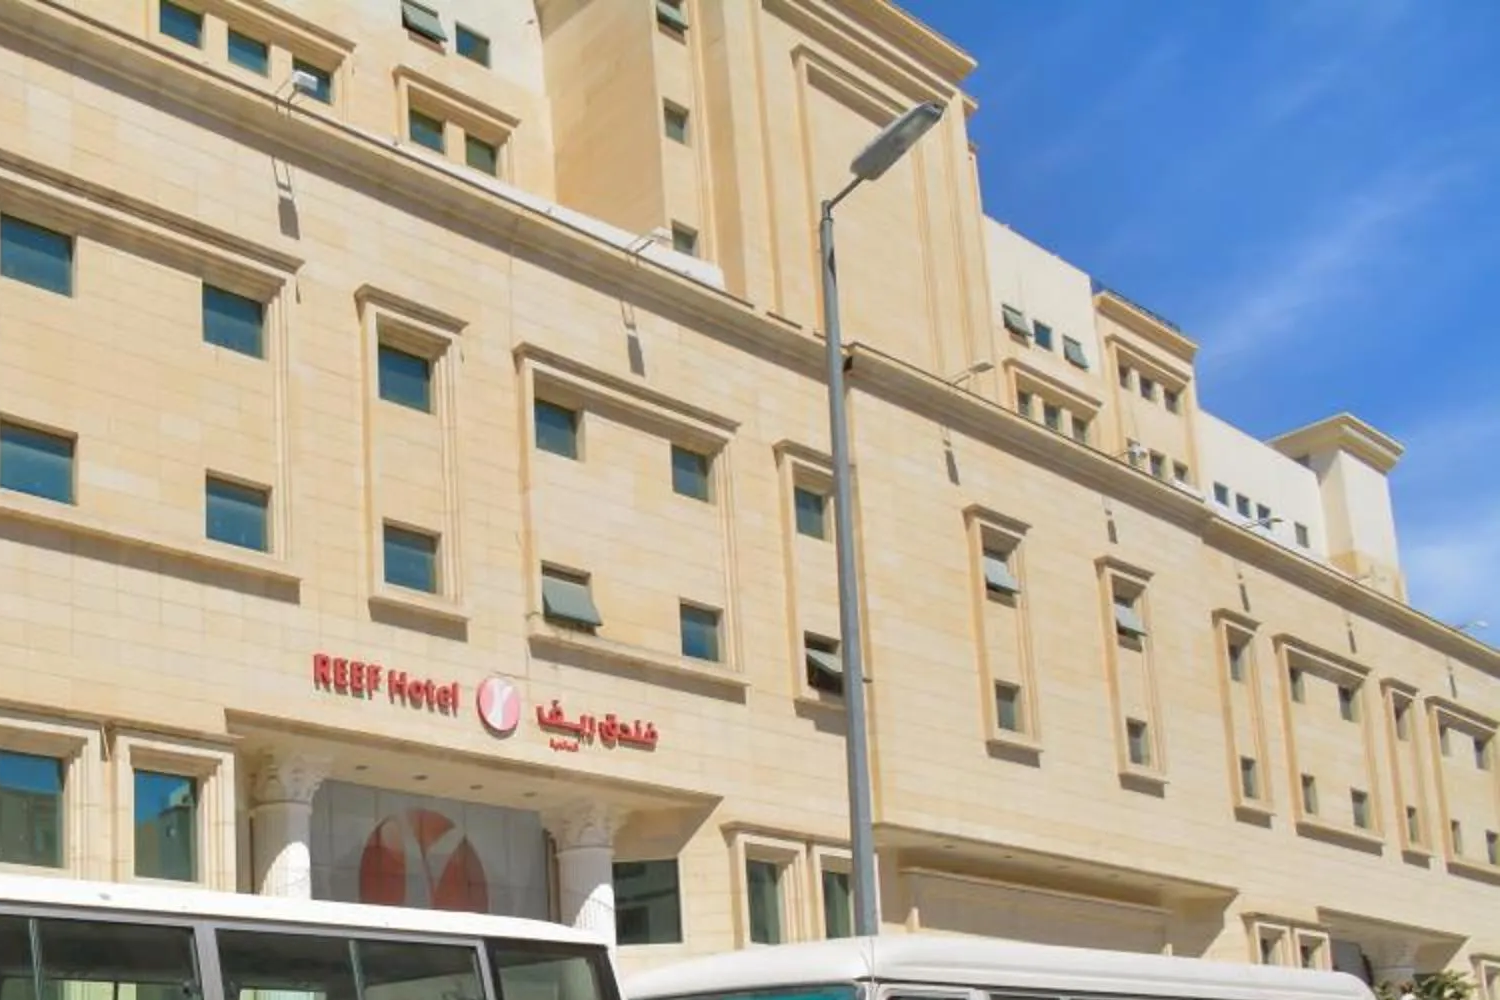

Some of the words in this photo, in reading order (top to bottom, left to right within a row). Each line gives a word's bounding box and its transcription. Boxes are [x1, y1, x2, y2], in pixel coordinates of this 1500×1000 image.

[314, 653, 381, 699] REEF
[388, 668, 459, 717] Hotel
[536, 699, 596, 742] ريف
[598, 713, 658, 750] فندق
